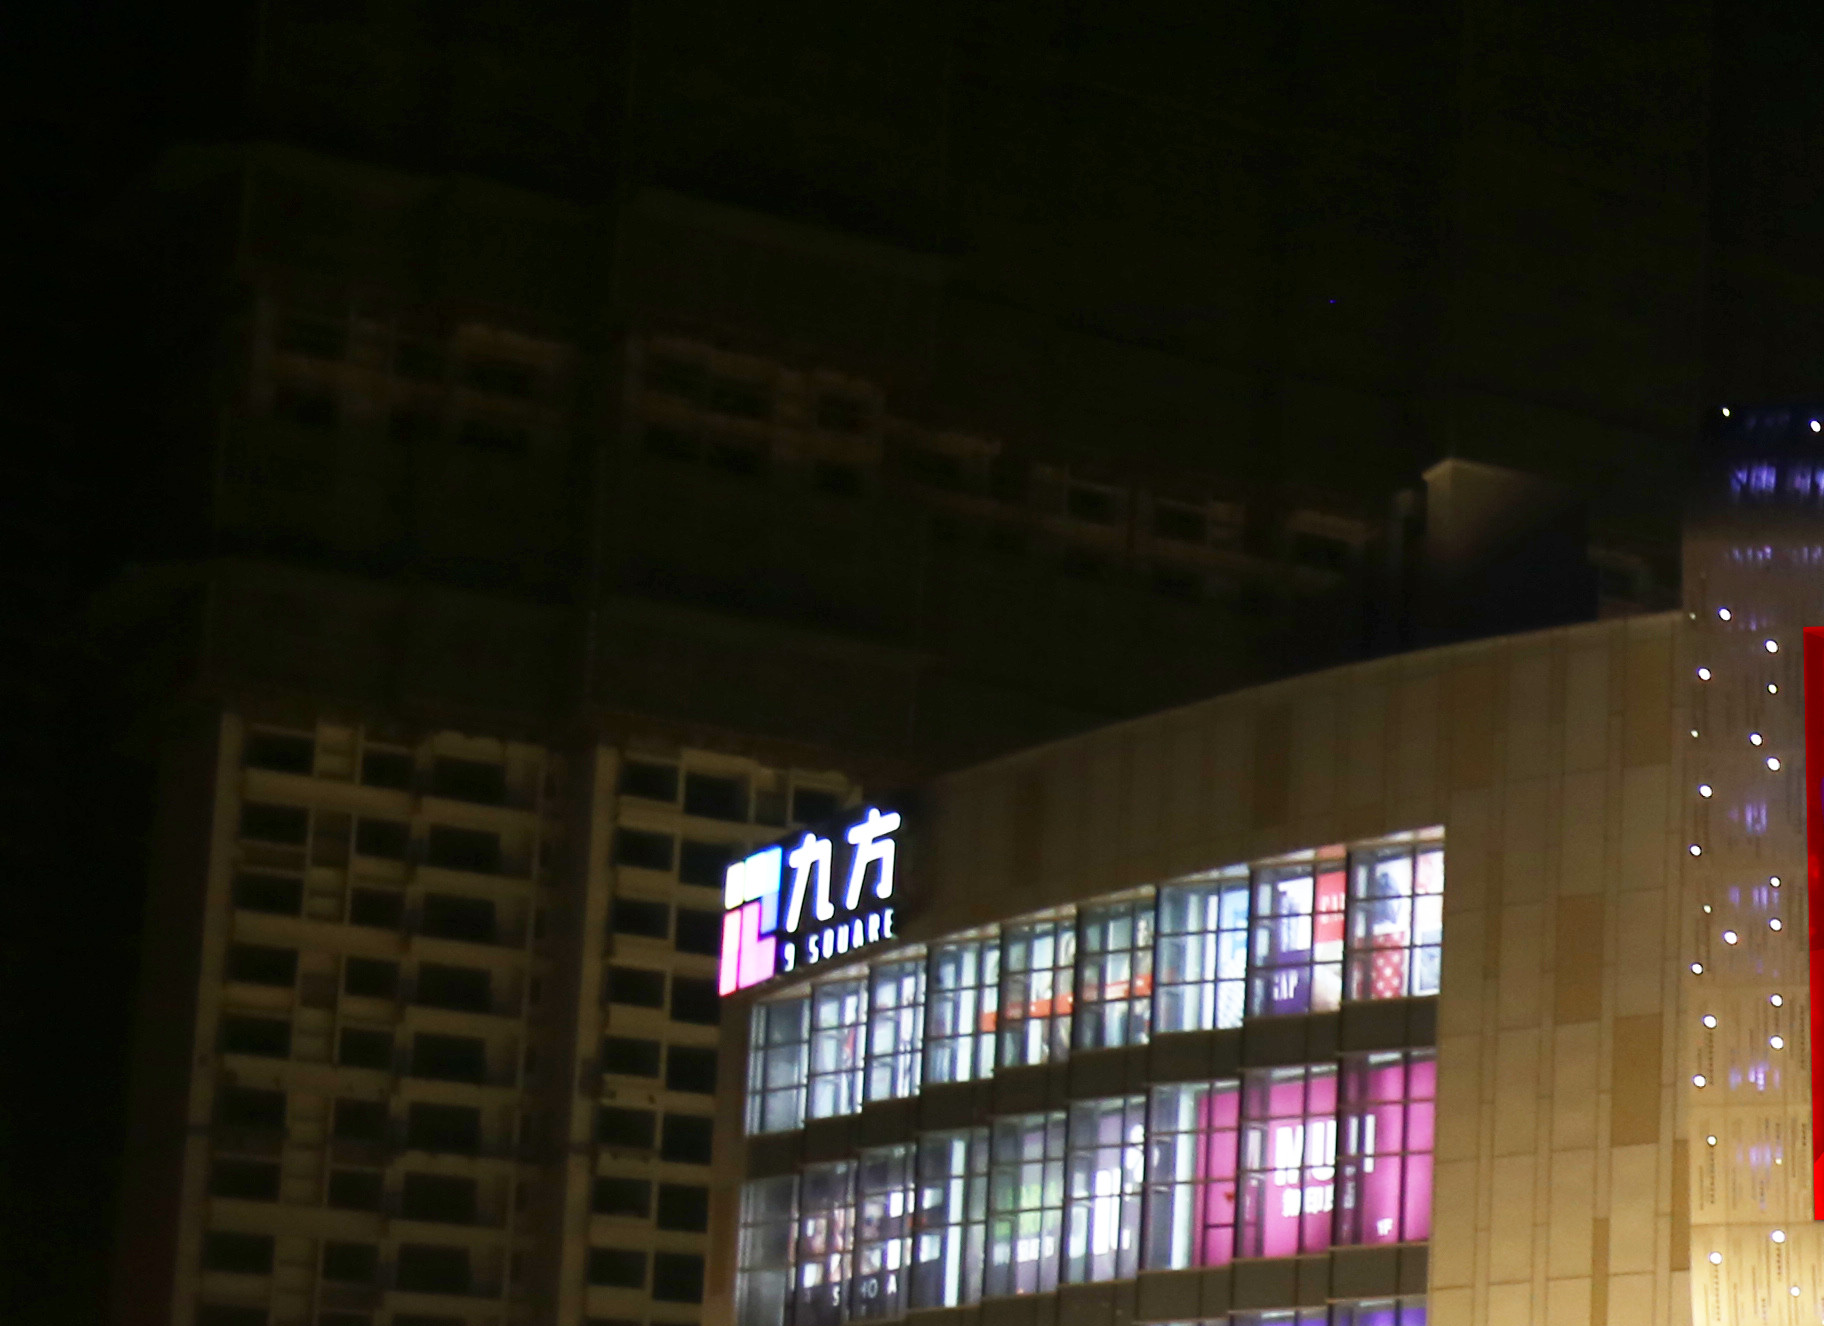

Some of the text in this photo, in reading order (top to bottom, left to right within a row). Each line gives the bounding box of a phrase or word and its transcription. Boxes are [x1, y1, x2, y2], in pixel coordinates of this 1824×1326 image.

[785, 807, 902, 933] 九方
[783, 907, 895, 973] 9 SQUARE
